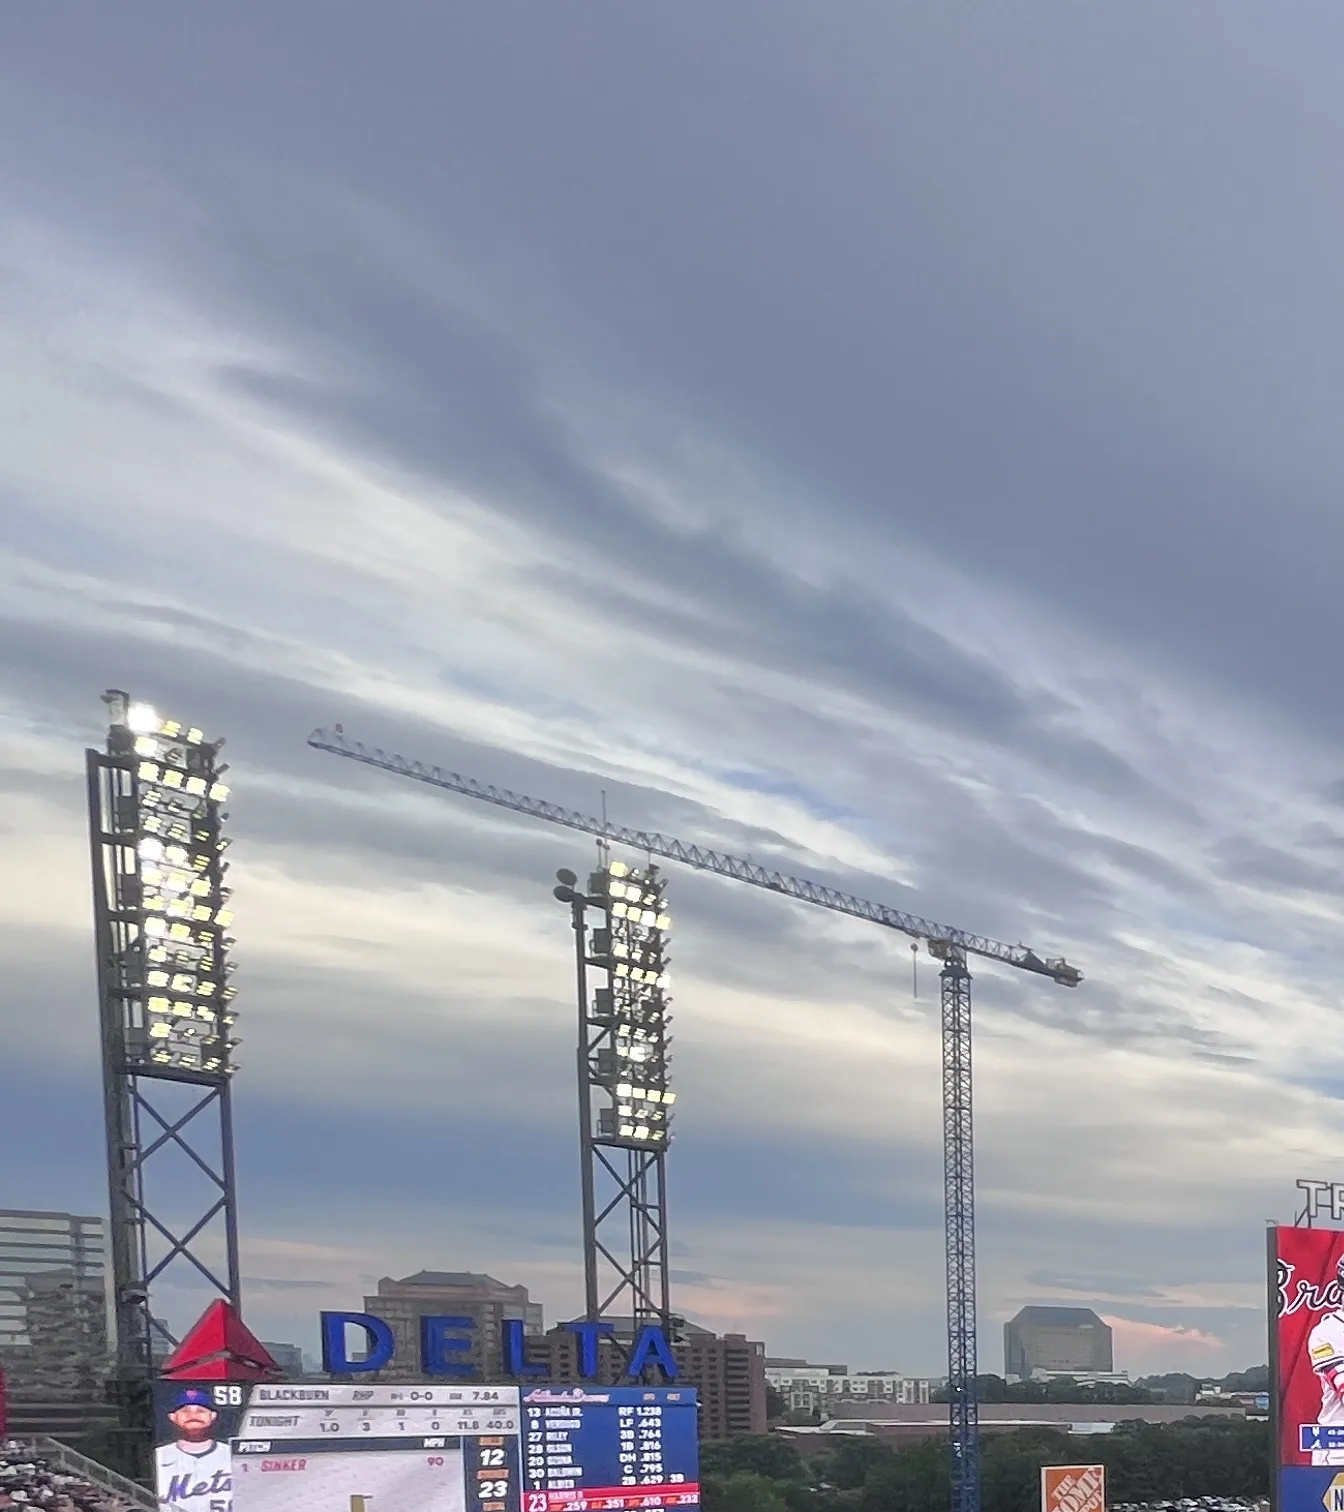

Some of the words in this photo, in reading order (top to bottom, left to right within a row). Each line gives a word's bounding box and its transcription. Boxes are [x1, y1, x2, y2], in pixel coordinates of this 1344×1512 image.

[321, 1311, 679, 1382] DELTA
[213, 1386, 242, 1405] 58
[411, 1391, 433, 1400] 0-0
[473, 1391, 499, 1400] 7.84
[527, 1408, 541, 1417] 13
[618, 1407, 633, 1416] RF
[320, 1422, 339, 1432] 1.0
[362, 1422, 371, 1431] 3
[431, 1421, 440, 1430] 0
[486, 1420, 514, 1429] 40.0
[620, 1419, 634, 1428] LF
[528, 1432, 542, 1442] 27
[261, 1459, 307, 1472] SINKER
[427, 1456, 444, 1466] 90
[480, 1449, 504, 1465] 12
[528, 1457, 544, 1466] 20
[620, 1453, 636, 1463] DH
[529, 1469, 545, 1479] 30
[624, 1465, 633, 1474] C
[479, 1481, 508, 1497] 23
[529, 1494, 547, 1512] 23
